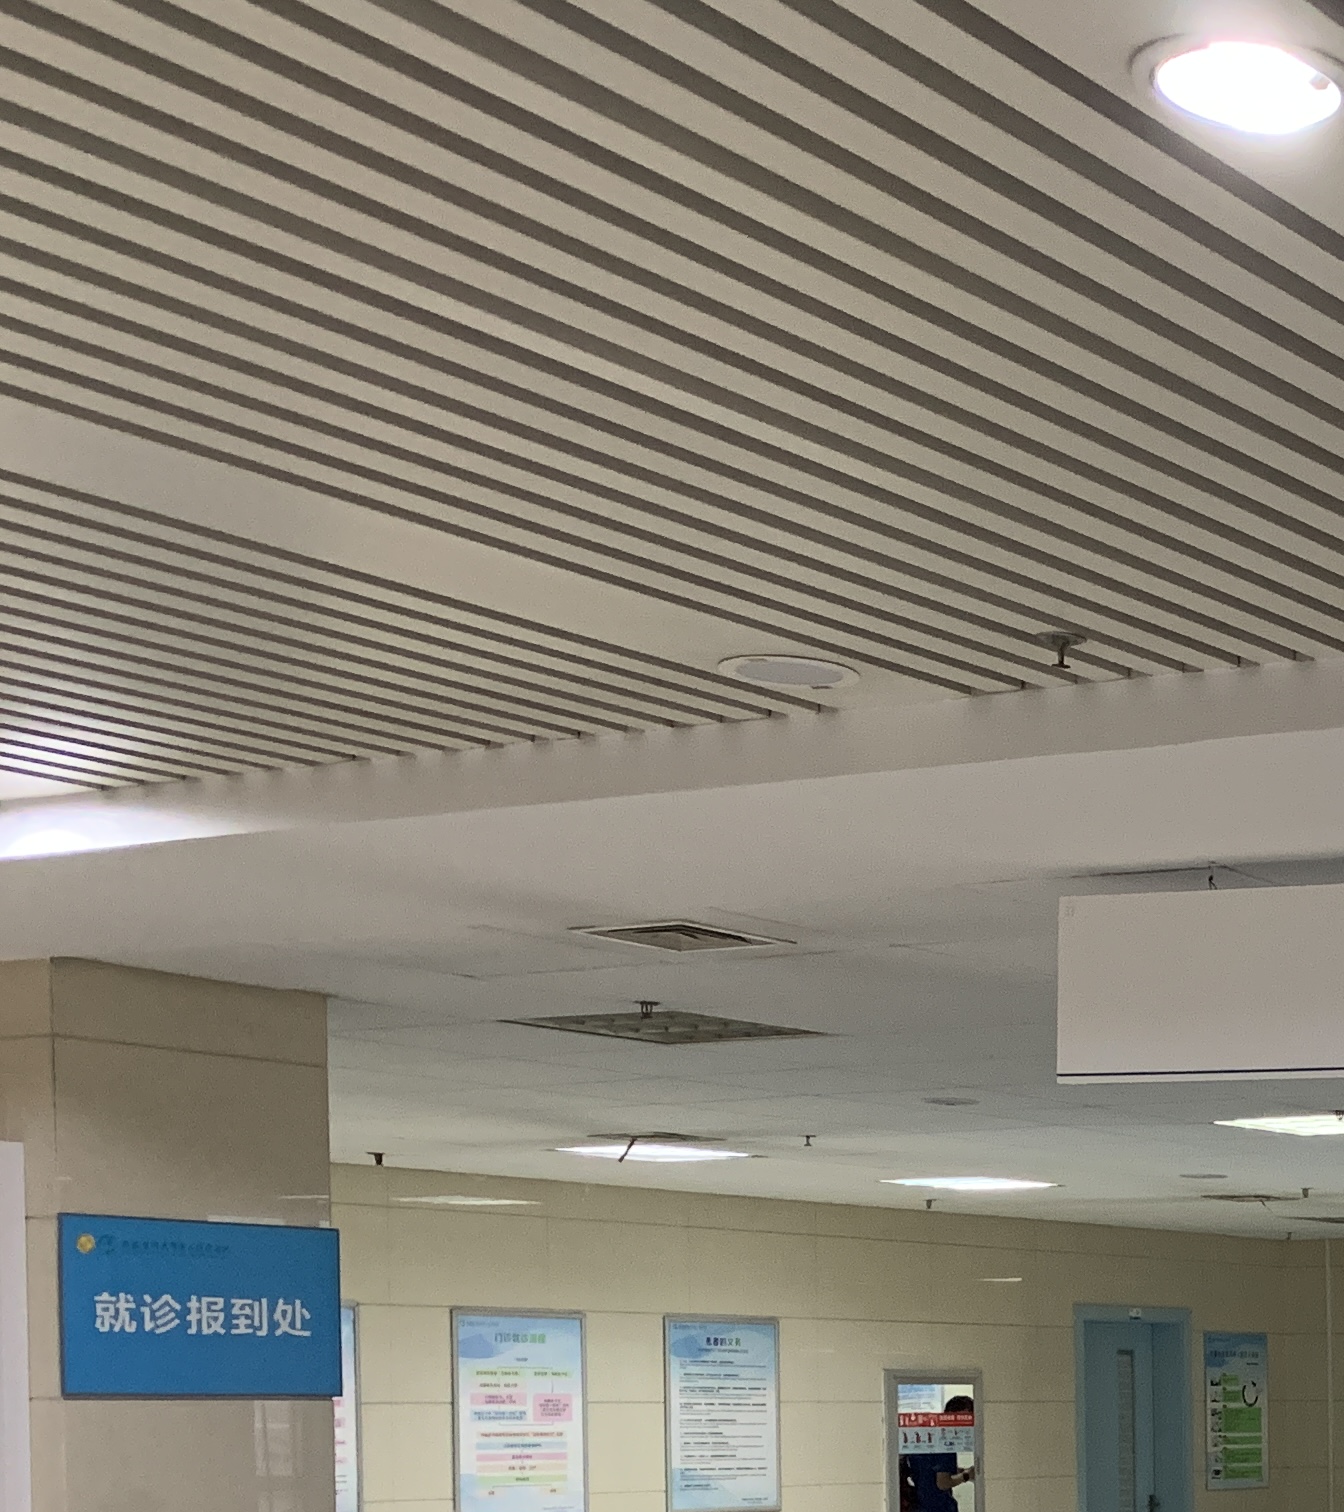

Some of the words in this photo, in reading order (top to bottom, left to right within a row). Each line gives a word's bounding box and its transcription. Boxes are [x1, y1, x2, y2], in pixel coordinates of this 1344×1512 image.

[94, 1291, 311, 1337] 就诊报到处
